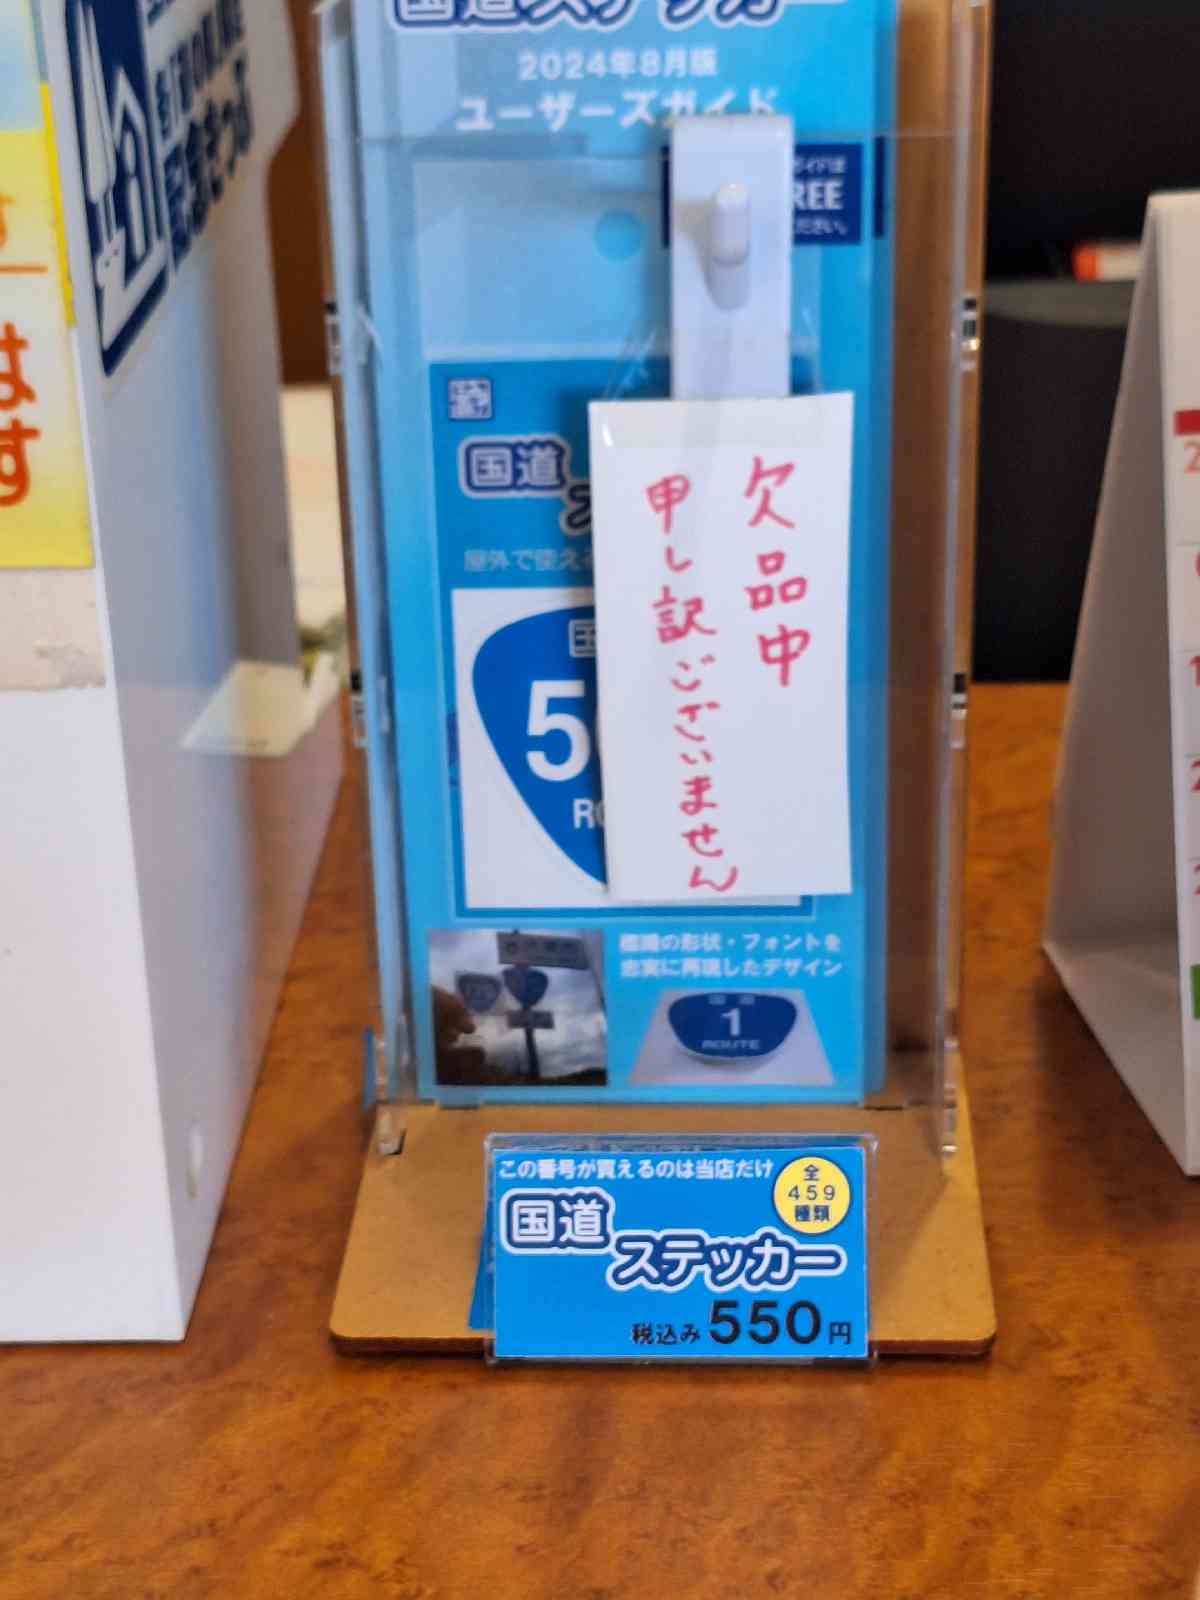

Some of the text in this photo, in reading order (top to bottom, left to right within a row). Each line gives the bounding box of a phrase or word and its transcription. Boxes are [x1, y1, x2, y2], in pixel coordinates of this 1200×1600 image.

[466, 441, 567, 491] 国道
[743, 455, 811, 688] 欠品中
[644, 473, 739, 892] 申し訳ございません
[720, 1007, 741, 1037] 1
[499, 1158, 774, 1181] この番号が買えるのは当店だけ
[788, 1184, 837, 1201] 459
[803, 1164, 819, 1182] 全
[506, 1192, 611, 1250] 国道
[794, 1204, 830, 1223] 種類
[611, 1232, 844, 1287] ステッカー
[630, 1300, 852, 1346] 税込み 550円
